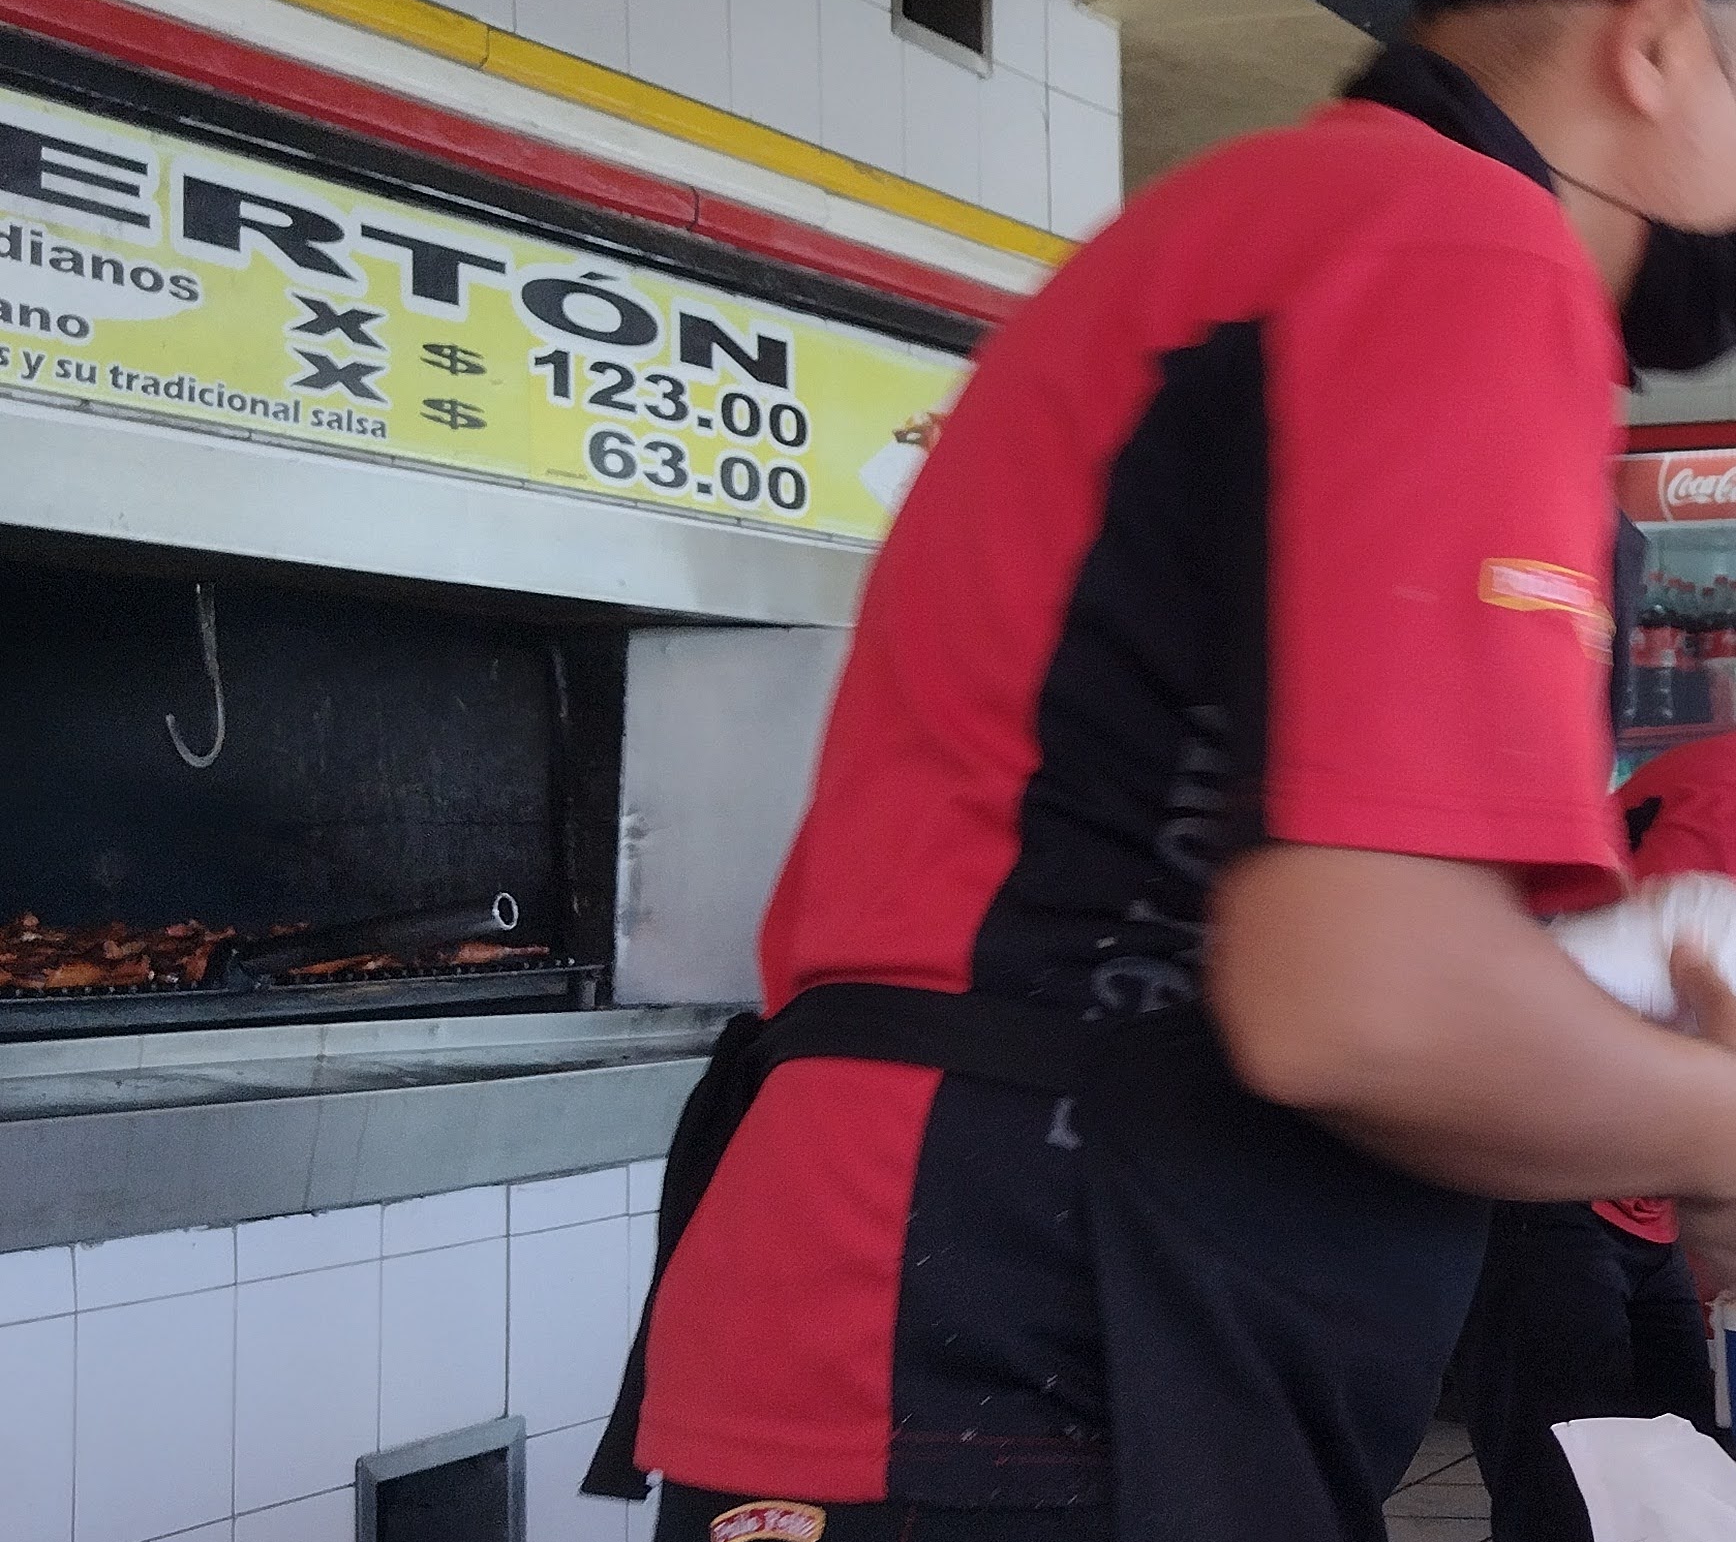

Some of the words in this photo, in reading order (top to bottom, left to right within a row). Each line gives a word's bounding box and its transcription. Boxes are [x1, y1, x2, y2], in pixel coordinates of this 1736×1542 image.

[0, 122, 789, 390] ERTÓN
[0, 224, 200, 304] dianos
[420, 342, 488, 377] $
[533, 348, 809, 449] 123.00
[21, 350, 46, 380] y
[55, 358, 97, 385] su
[109, 363, 300, 424] tradicional
[310, 405, 389, 440] salsa
[420, 397, 488, 431] $
[587, 429, 807, 511] 63.00
